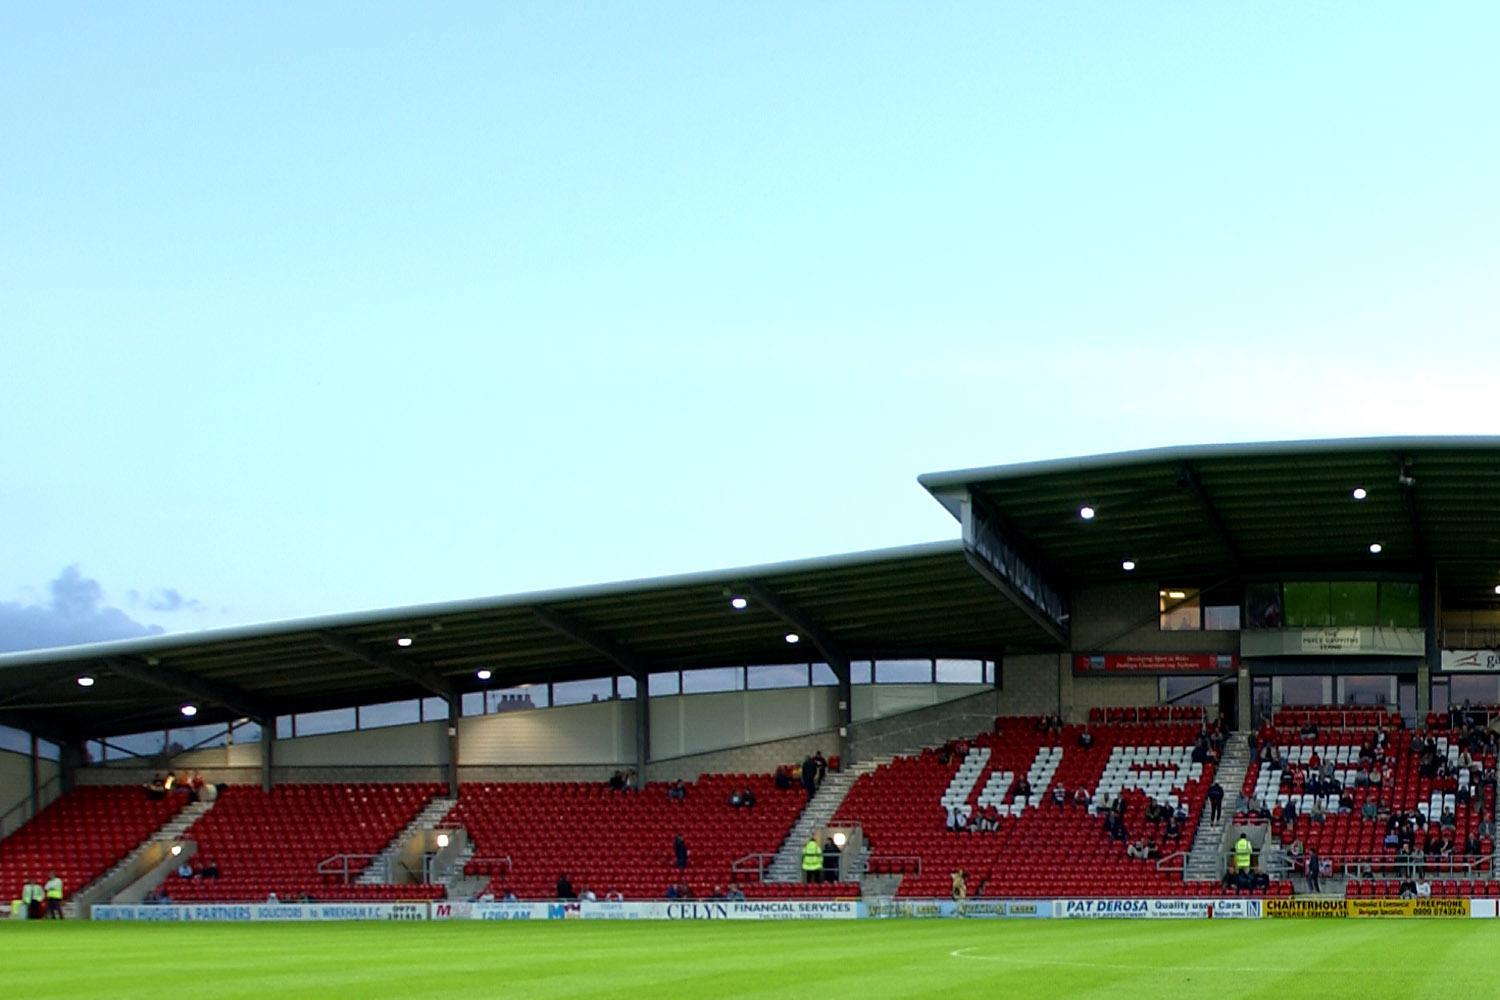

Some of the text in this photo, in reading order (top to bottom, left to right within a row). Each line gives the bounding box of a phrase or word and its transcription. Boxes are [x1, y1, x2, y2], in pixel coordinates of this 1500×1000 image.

[734, 902, 851, 913] FINANCIAL SERVICES
[1066, 901, 1148, 912] PAT DEROSA
[1154, 901, 1198, 911] Quality
[1218, 901, 1241, 910] Cars
[1267, 901, 1348, 910] CHARTERHOUSE
[1416, 900, 1463, 908] FREEPHONE
[138, 906, 180, 920] HUGHES
[195, 905, 252, 919] PARTNERS
[322, 907, 366, 918] WREXHAM
[667, 903, 728, 919] CELYN
